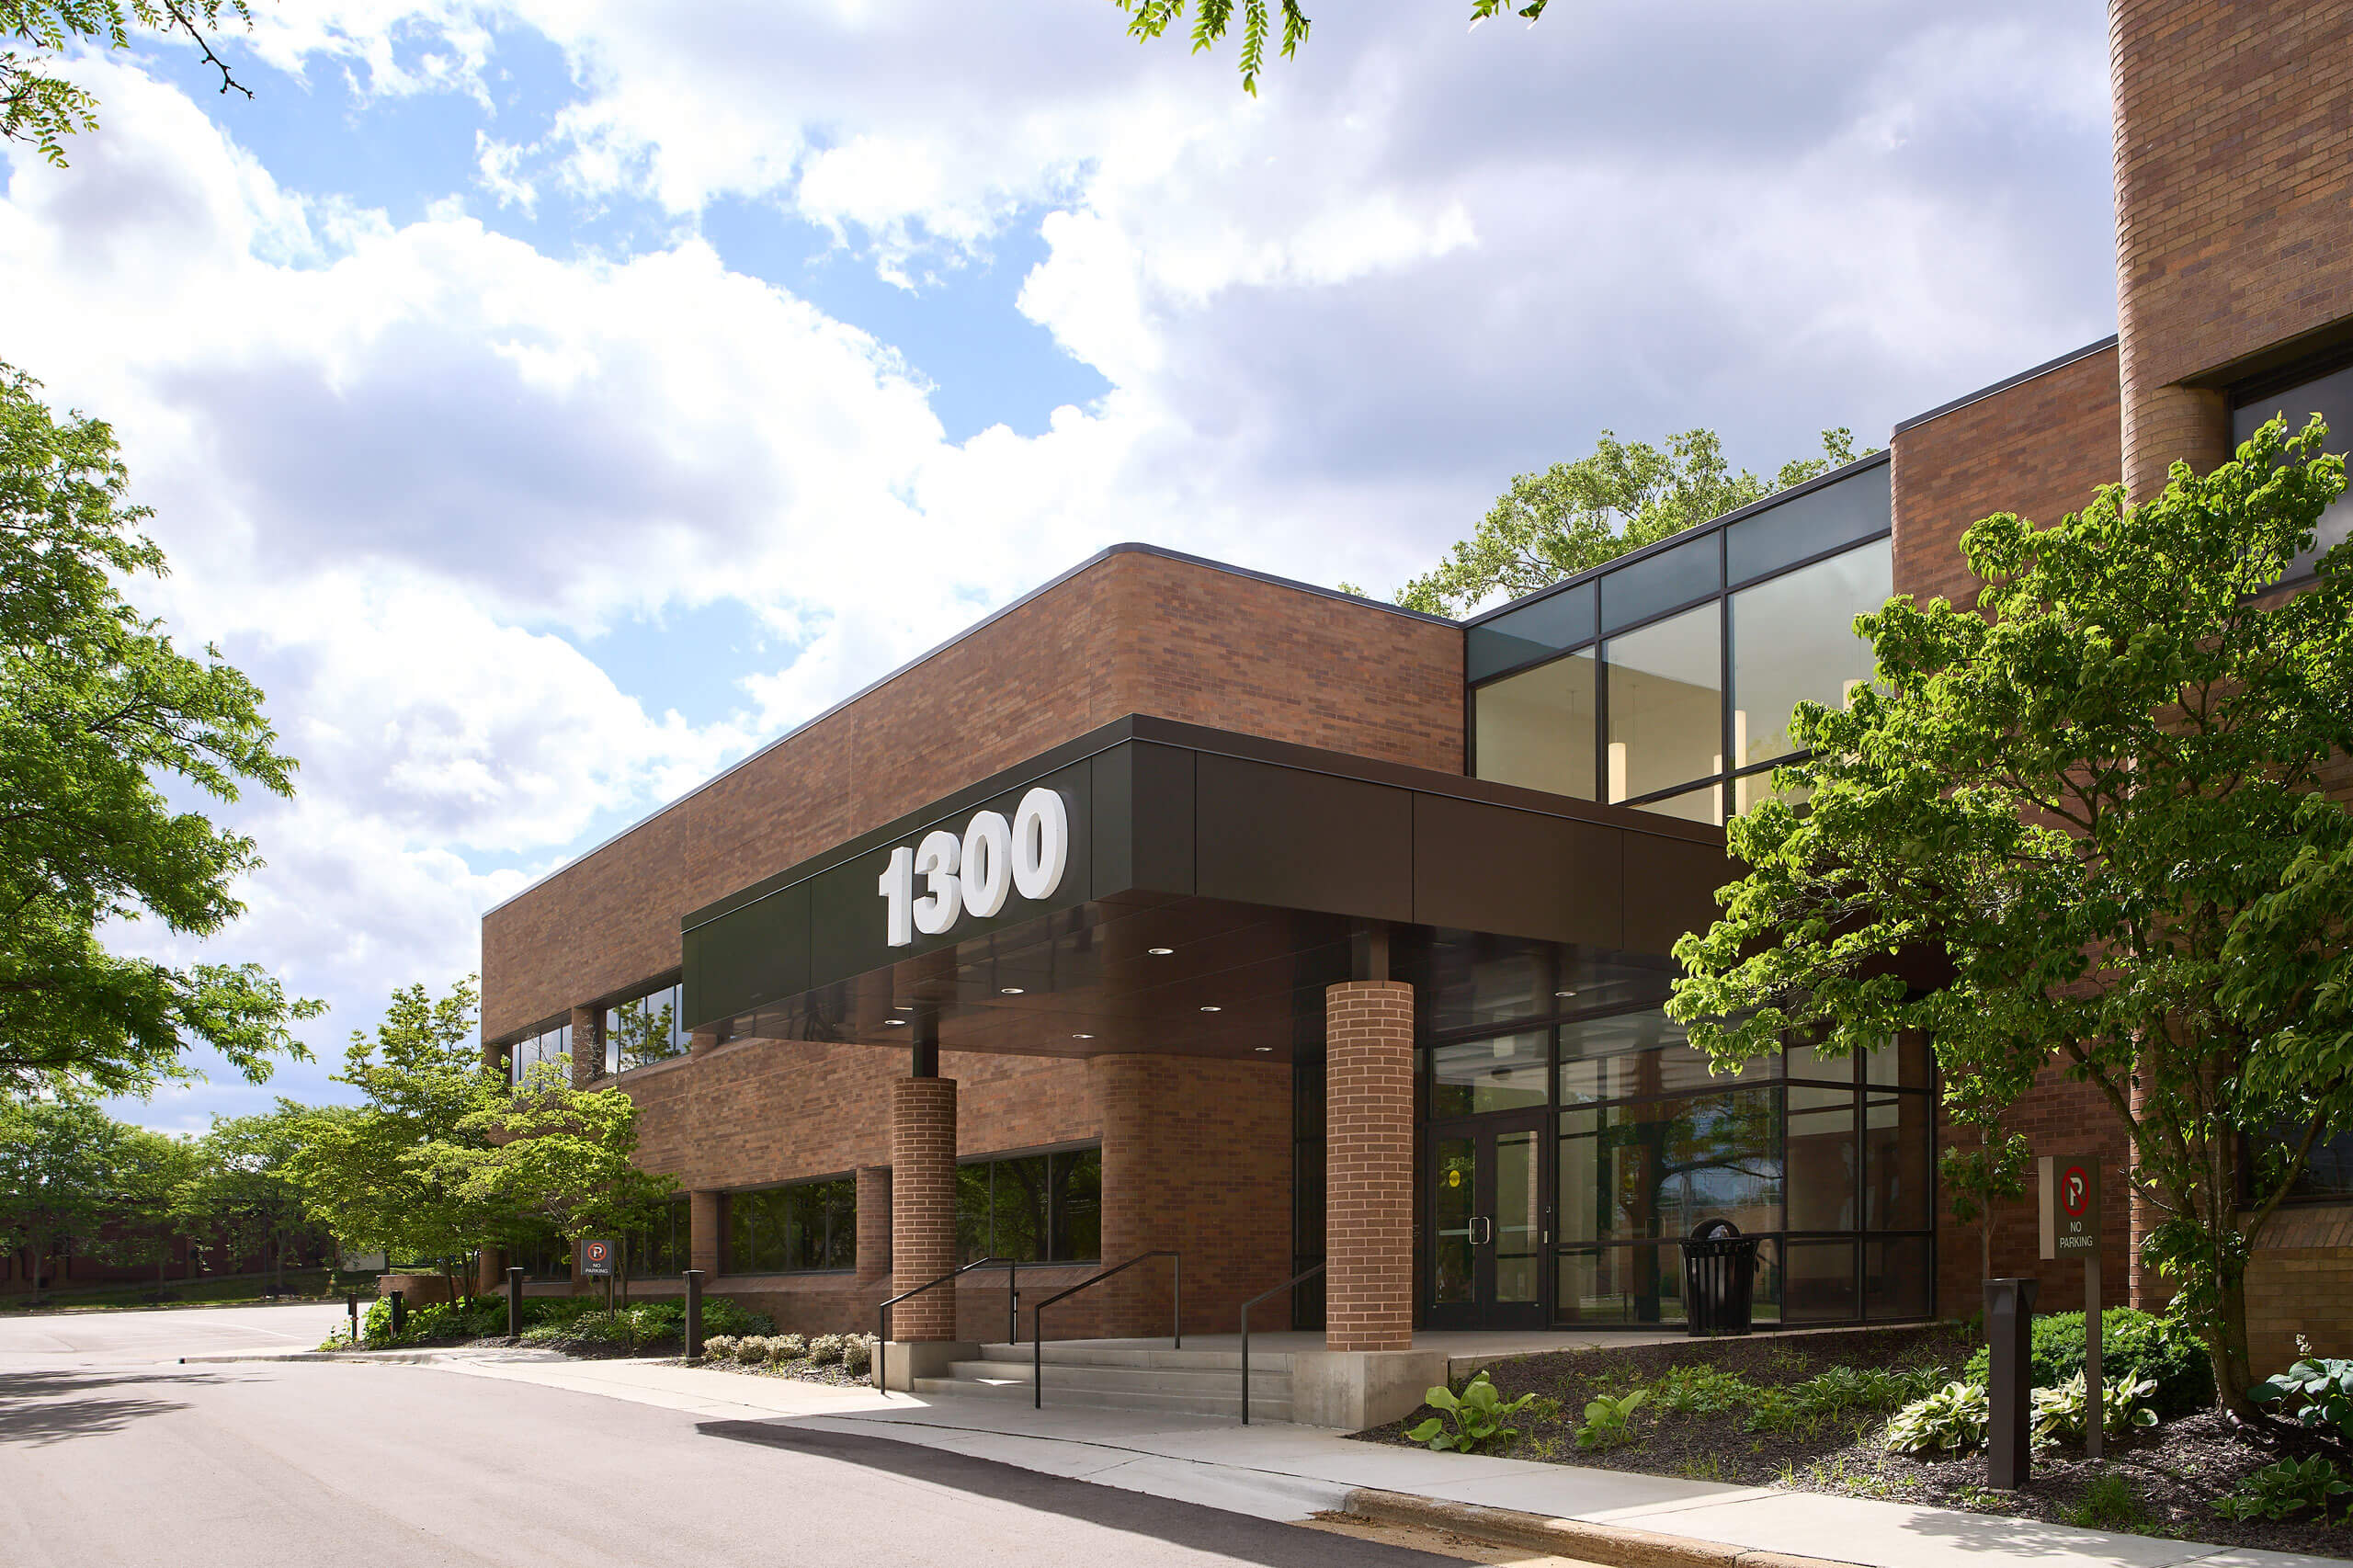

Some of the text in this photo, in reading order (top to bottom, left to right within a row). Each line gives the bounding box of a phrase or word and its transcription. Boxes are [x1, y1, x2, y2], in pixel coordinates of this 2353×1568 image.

[879, 788, 1068, 947] 1300
[2070, 1221, 2082, 1233] NO
[2060, 1235, 2093, 1248] PARKING
